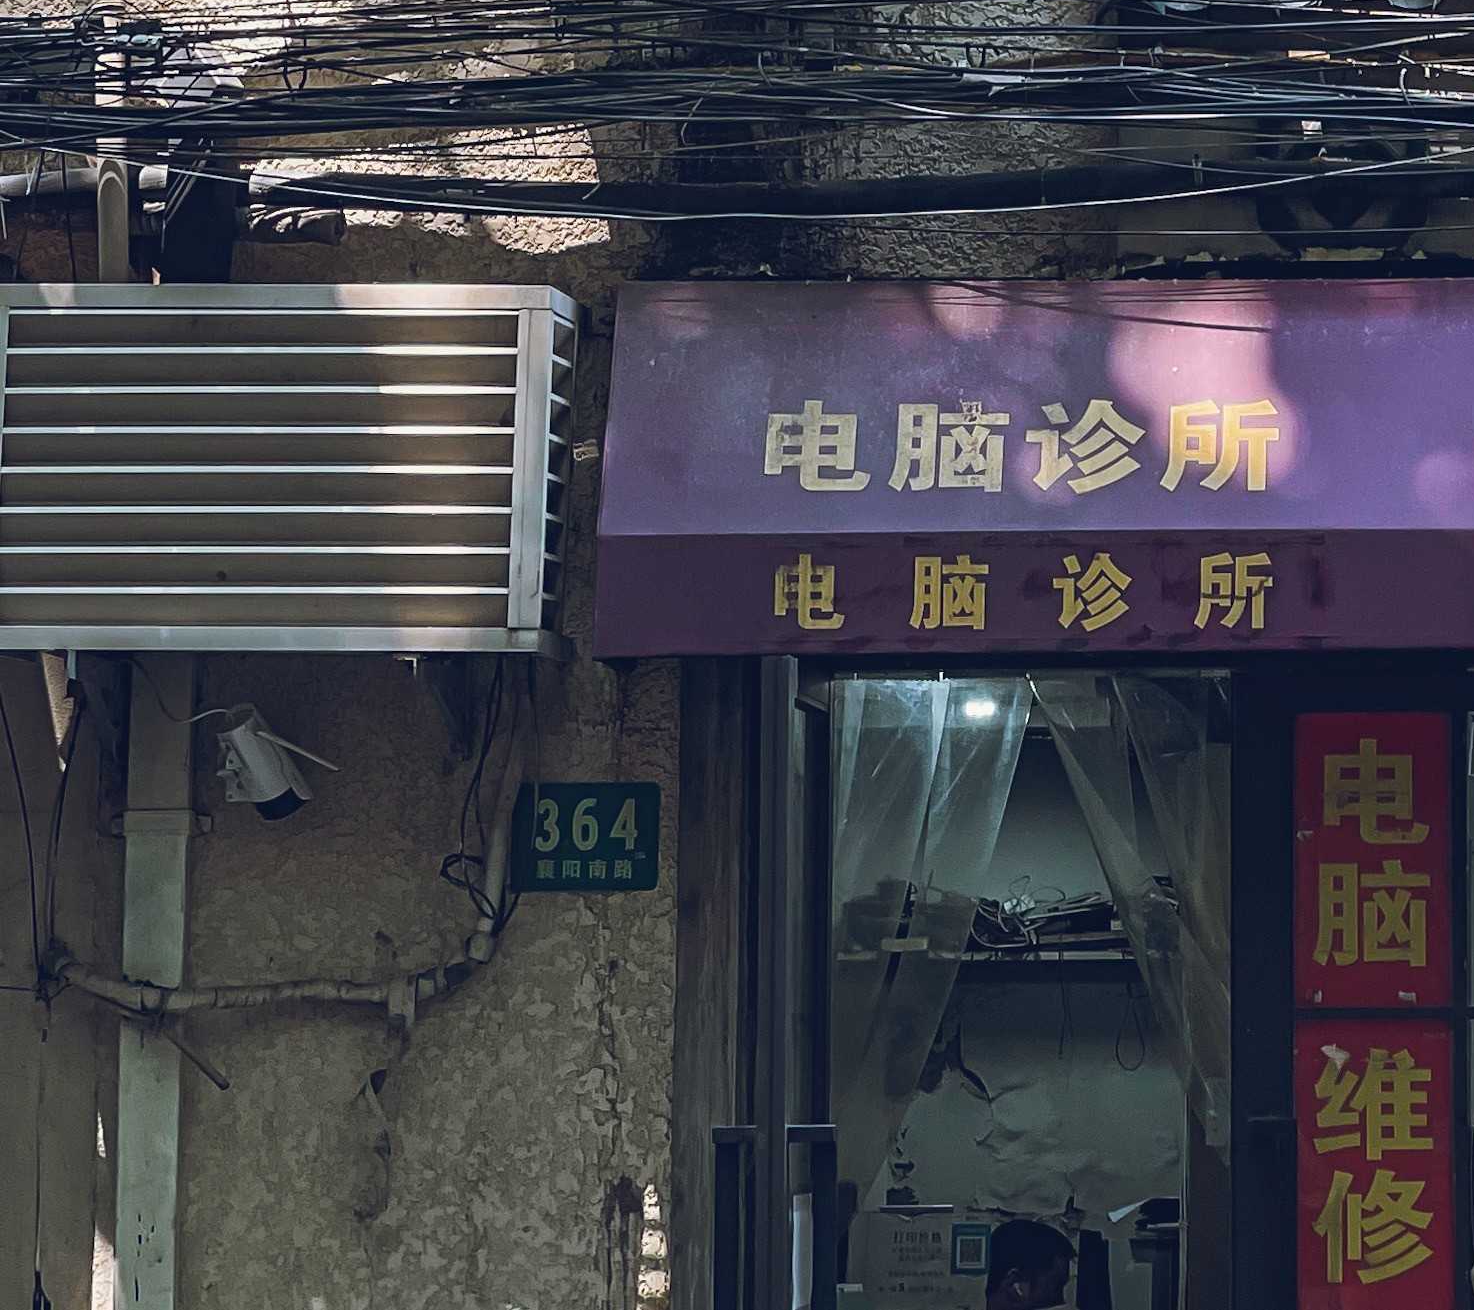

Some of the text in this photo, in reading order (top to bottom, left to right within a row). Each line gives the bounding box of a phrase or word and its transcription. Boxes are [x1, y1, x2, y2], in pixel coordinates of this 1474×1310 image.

[762, 397, 1282, 496] 电脑诊所
[772, 551, 1275, 634] 电脑诊所
[535, 797, 638, 852] 364
[536, 859, 633, 880] 襄阳南路
[1311, 737, 1436, 1285] 电脑维修
